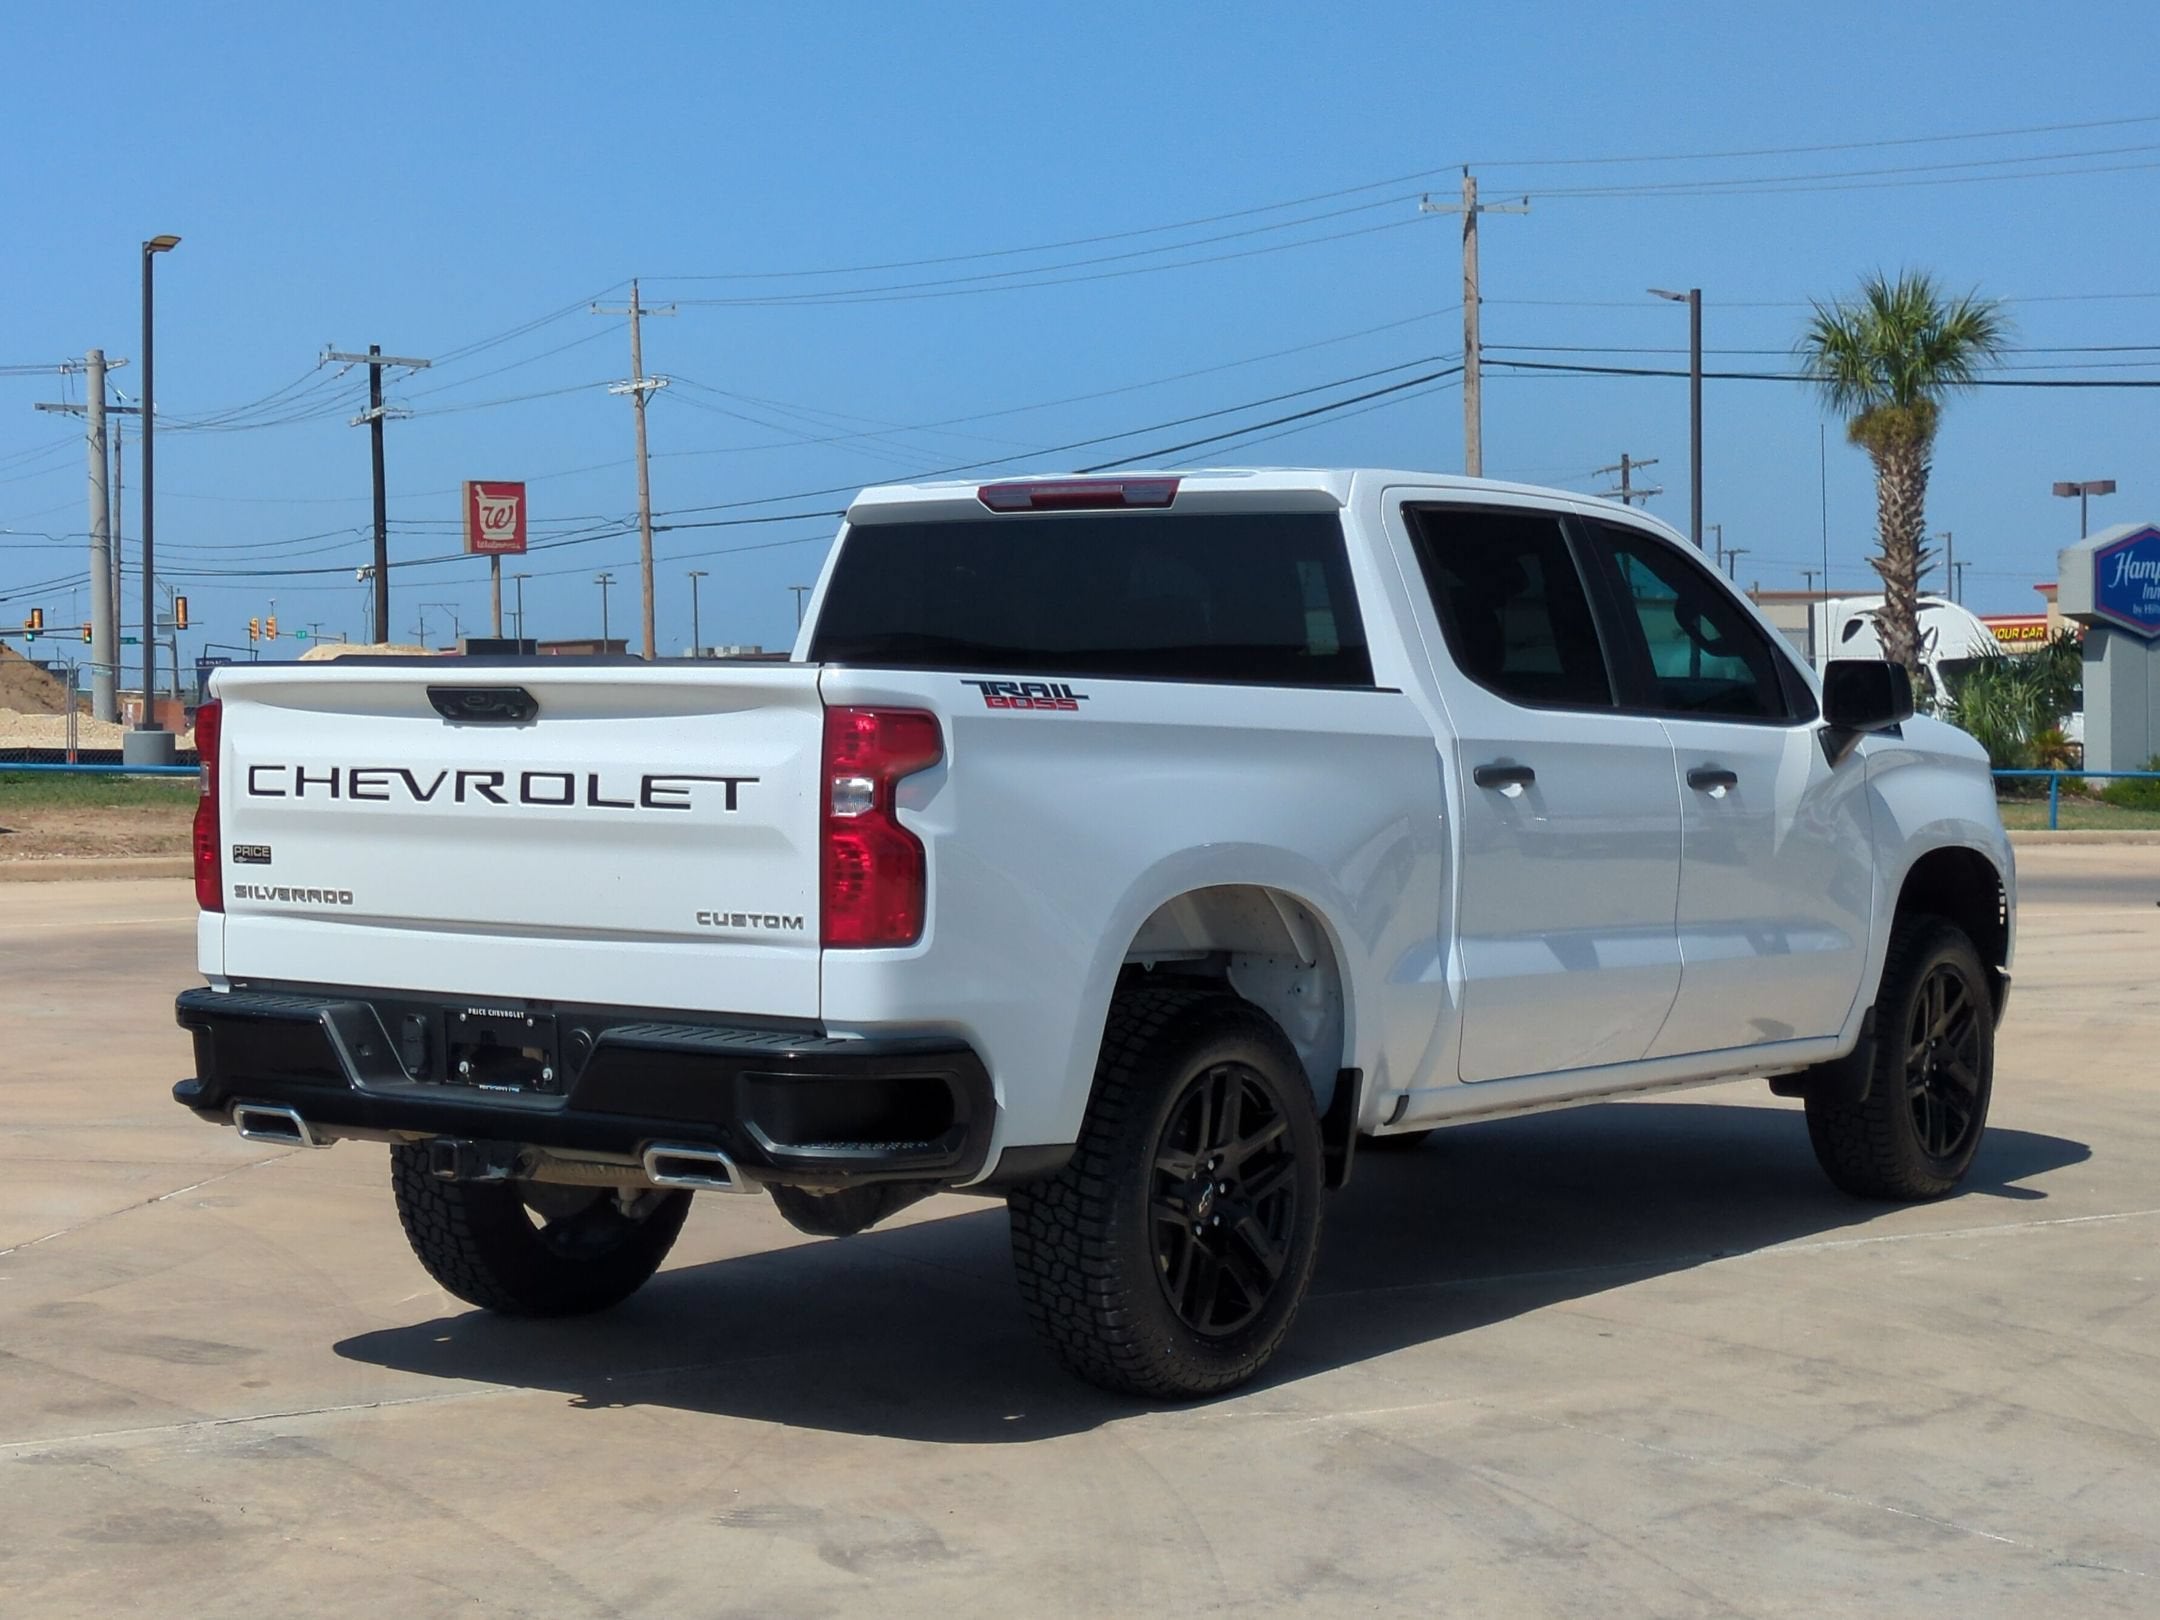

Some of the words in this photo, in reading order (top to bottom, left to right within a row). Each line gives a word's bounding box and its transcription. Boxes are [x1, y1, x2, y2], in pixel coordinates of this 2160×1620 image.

[1992, 627, 2020, 639] YOUR
[2021, 626, 2044, 639] CAR
[960, 680, 1090, 700] TRAIL
[984, 695, 1079, 711] BOSS
[248, 765, 760, 811] CHEVROLET
[234, 846, 270, 857] PRICE
[234, 885, 353, 905] SILVERADO
[696, 911, 804, 930] CUSTOM
[468, 1008, 487, 1016] PRICE
